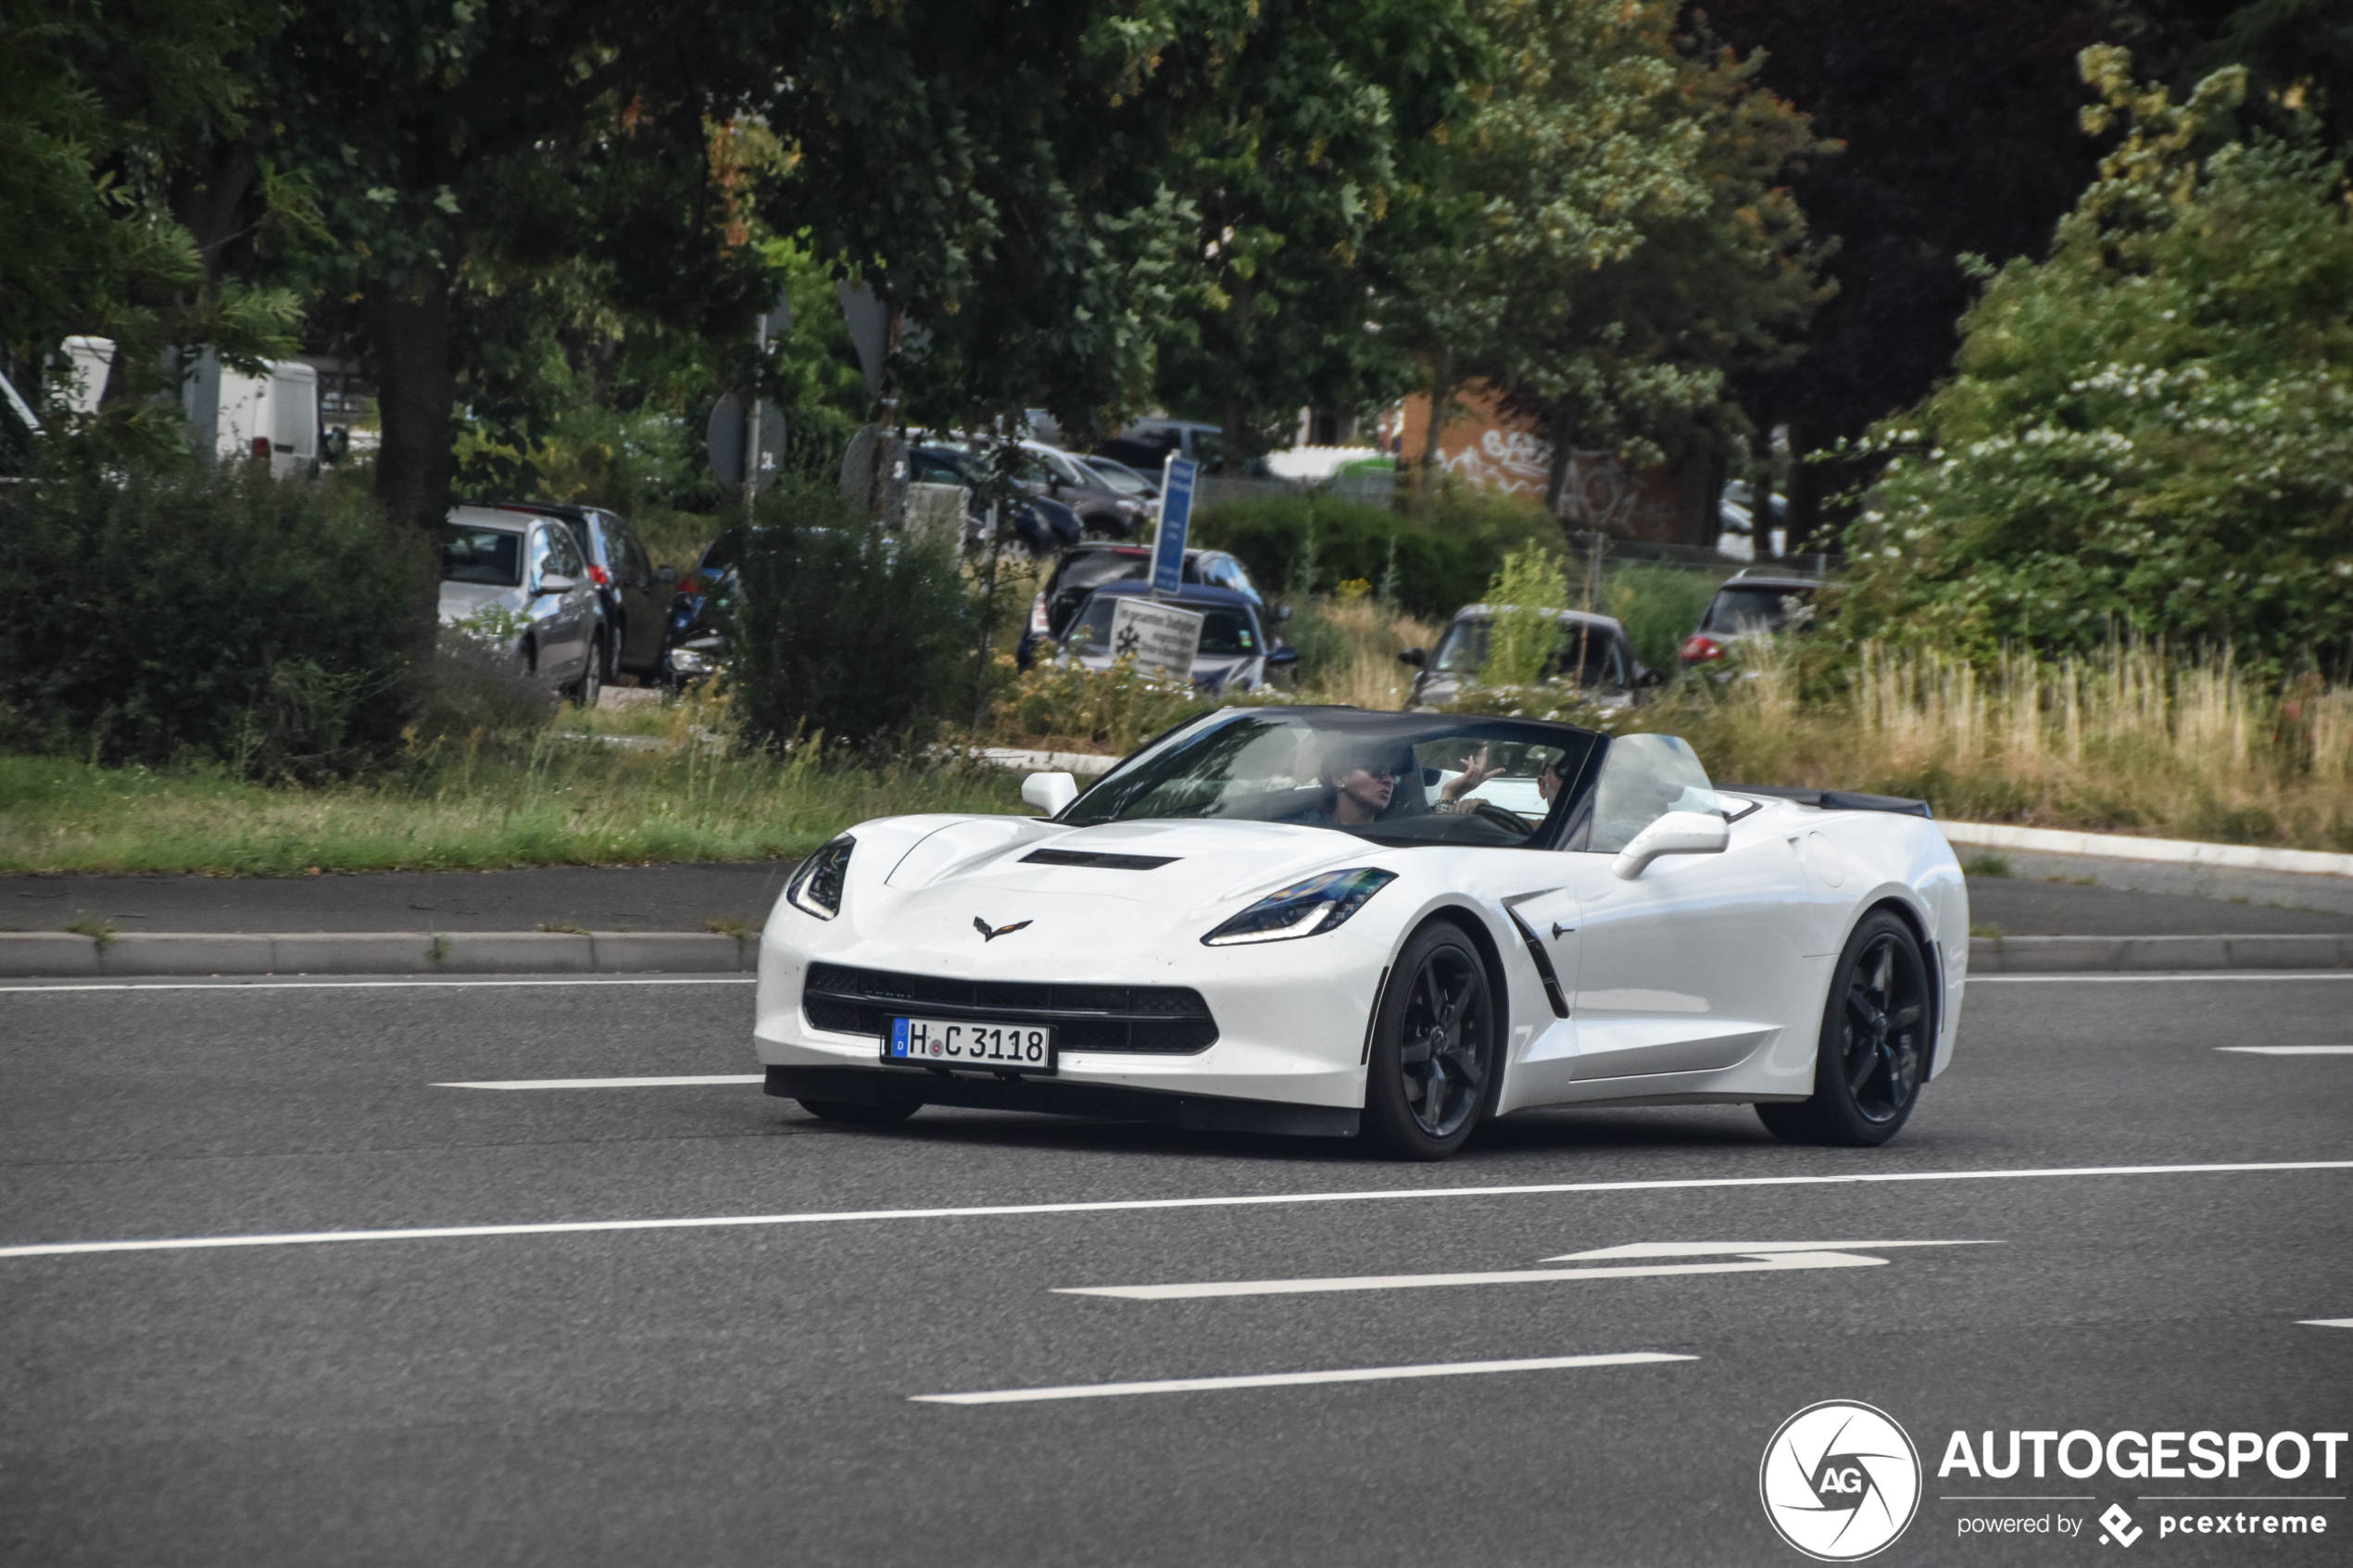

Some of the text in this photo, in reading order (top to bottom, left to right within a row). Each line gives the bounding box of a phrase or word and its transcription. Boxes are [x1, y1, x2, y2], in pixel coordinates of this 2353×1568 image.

[897, 1040, 904, 1051] D
[910, 1023, 1043, 1062] H C 3118
